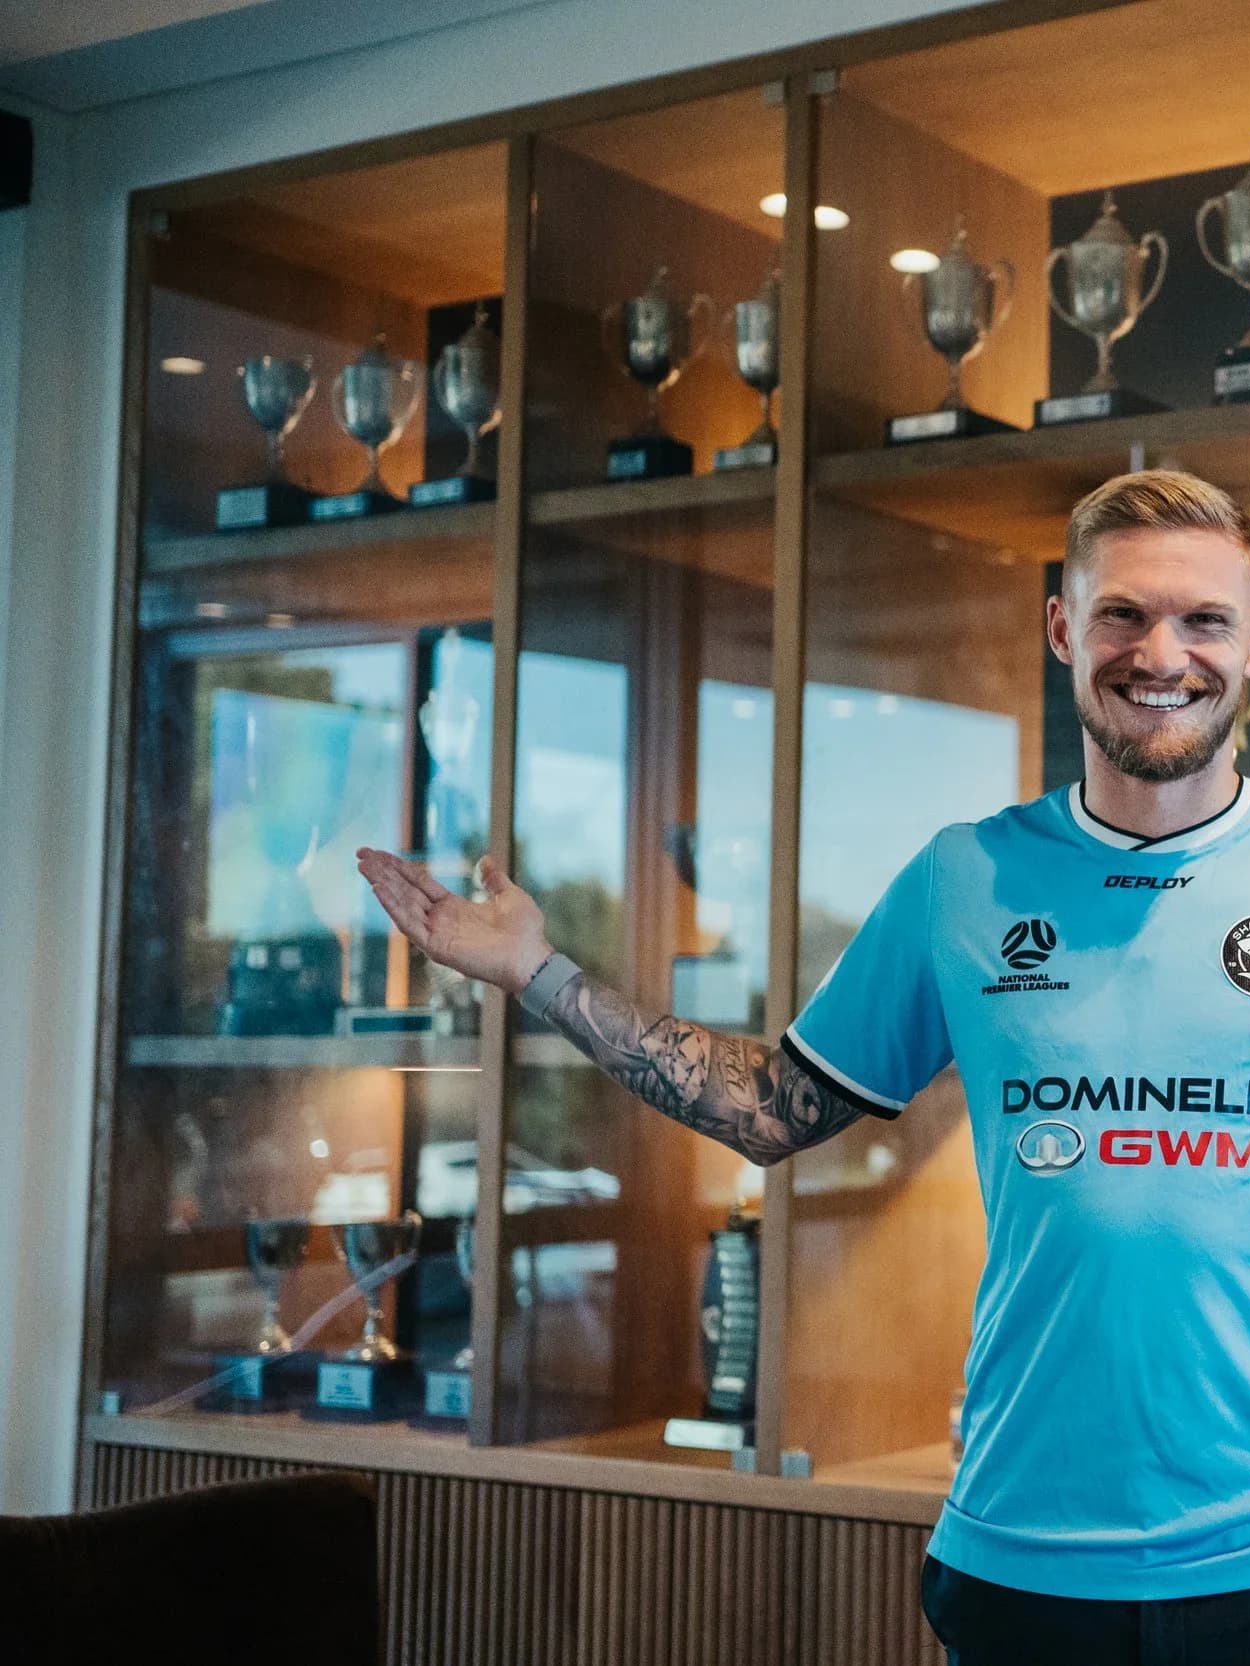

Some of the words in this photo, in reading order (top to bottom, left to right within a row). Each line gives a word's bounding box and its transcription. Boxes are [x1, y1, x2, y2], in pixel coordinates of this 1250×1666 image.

[1103, 875, 1195, 890] DEPLOY
[998, 973, 1051, 984] NATIONAL
[982, 983, 1022, 996] PREMIER
[1023, 982, 1070, 992] LEAGUES
